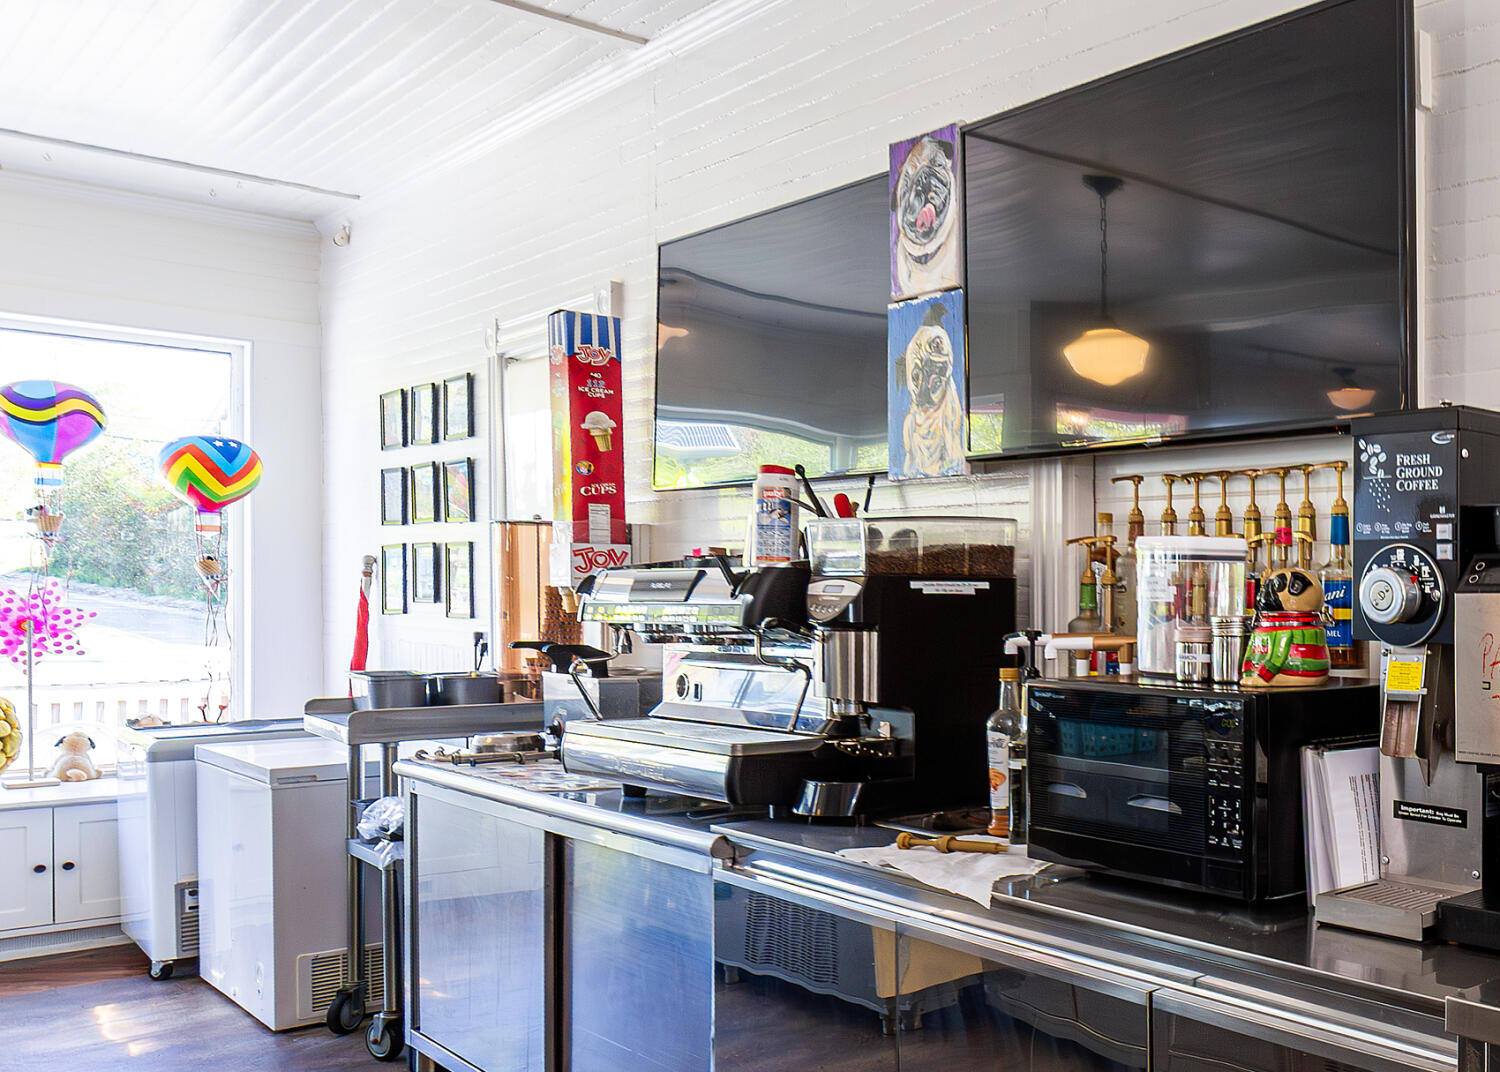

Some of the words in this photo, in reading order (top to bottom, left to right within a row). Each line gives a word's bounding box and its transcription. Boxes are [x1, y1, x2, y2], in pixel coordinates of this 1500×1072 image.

[1395, 453, 1431, 466] FRESH
[1395, 466, 1443, 479] GROUND
[580, 485, 617, 496] CUPS
[1395, 479, 1439, 492] COFFEE
[1325, 585, 1346, 601] ani
